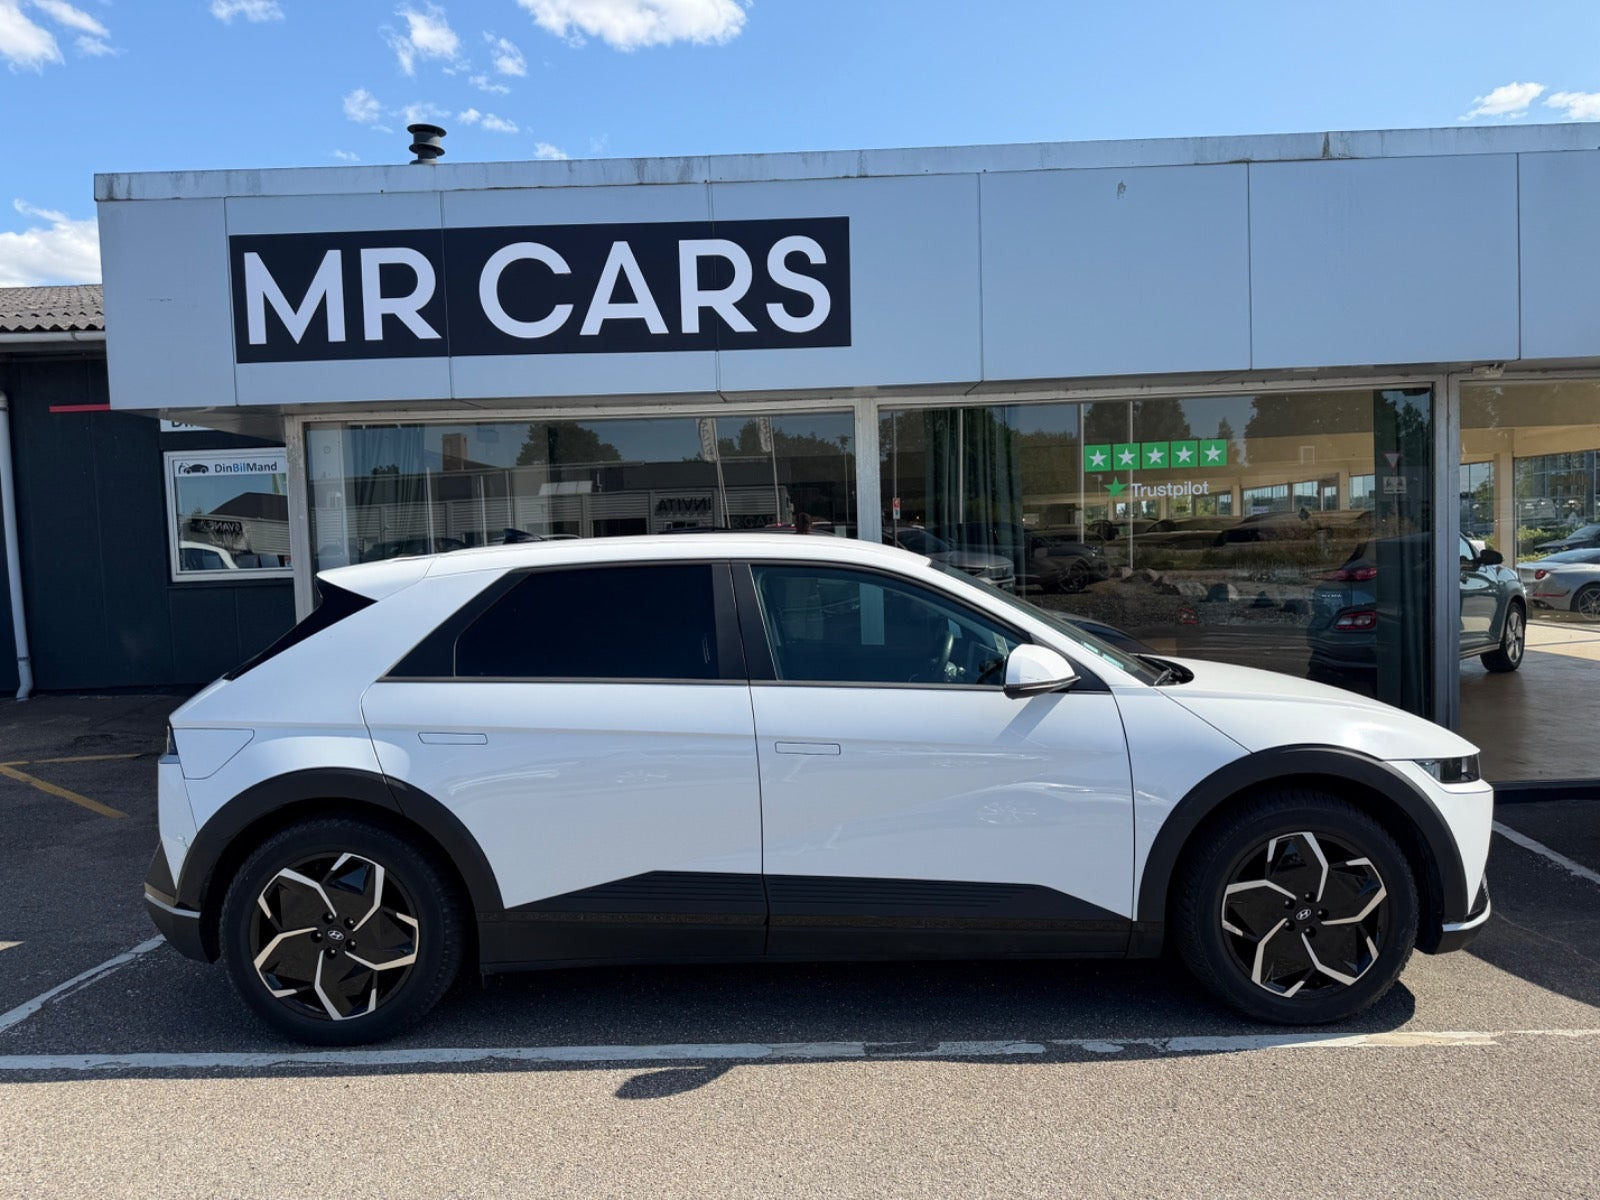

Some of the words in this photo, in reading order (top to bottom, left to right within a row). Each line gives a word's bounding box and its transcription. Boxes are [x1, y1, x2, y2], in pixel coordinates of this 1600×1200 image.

[244, 247, 442, 345] MR
[479, 235, 831, 338] CARS
[214, 461, 278, 473] DinBilMand
[1131, 480, 1209, 498] Trustpilot
